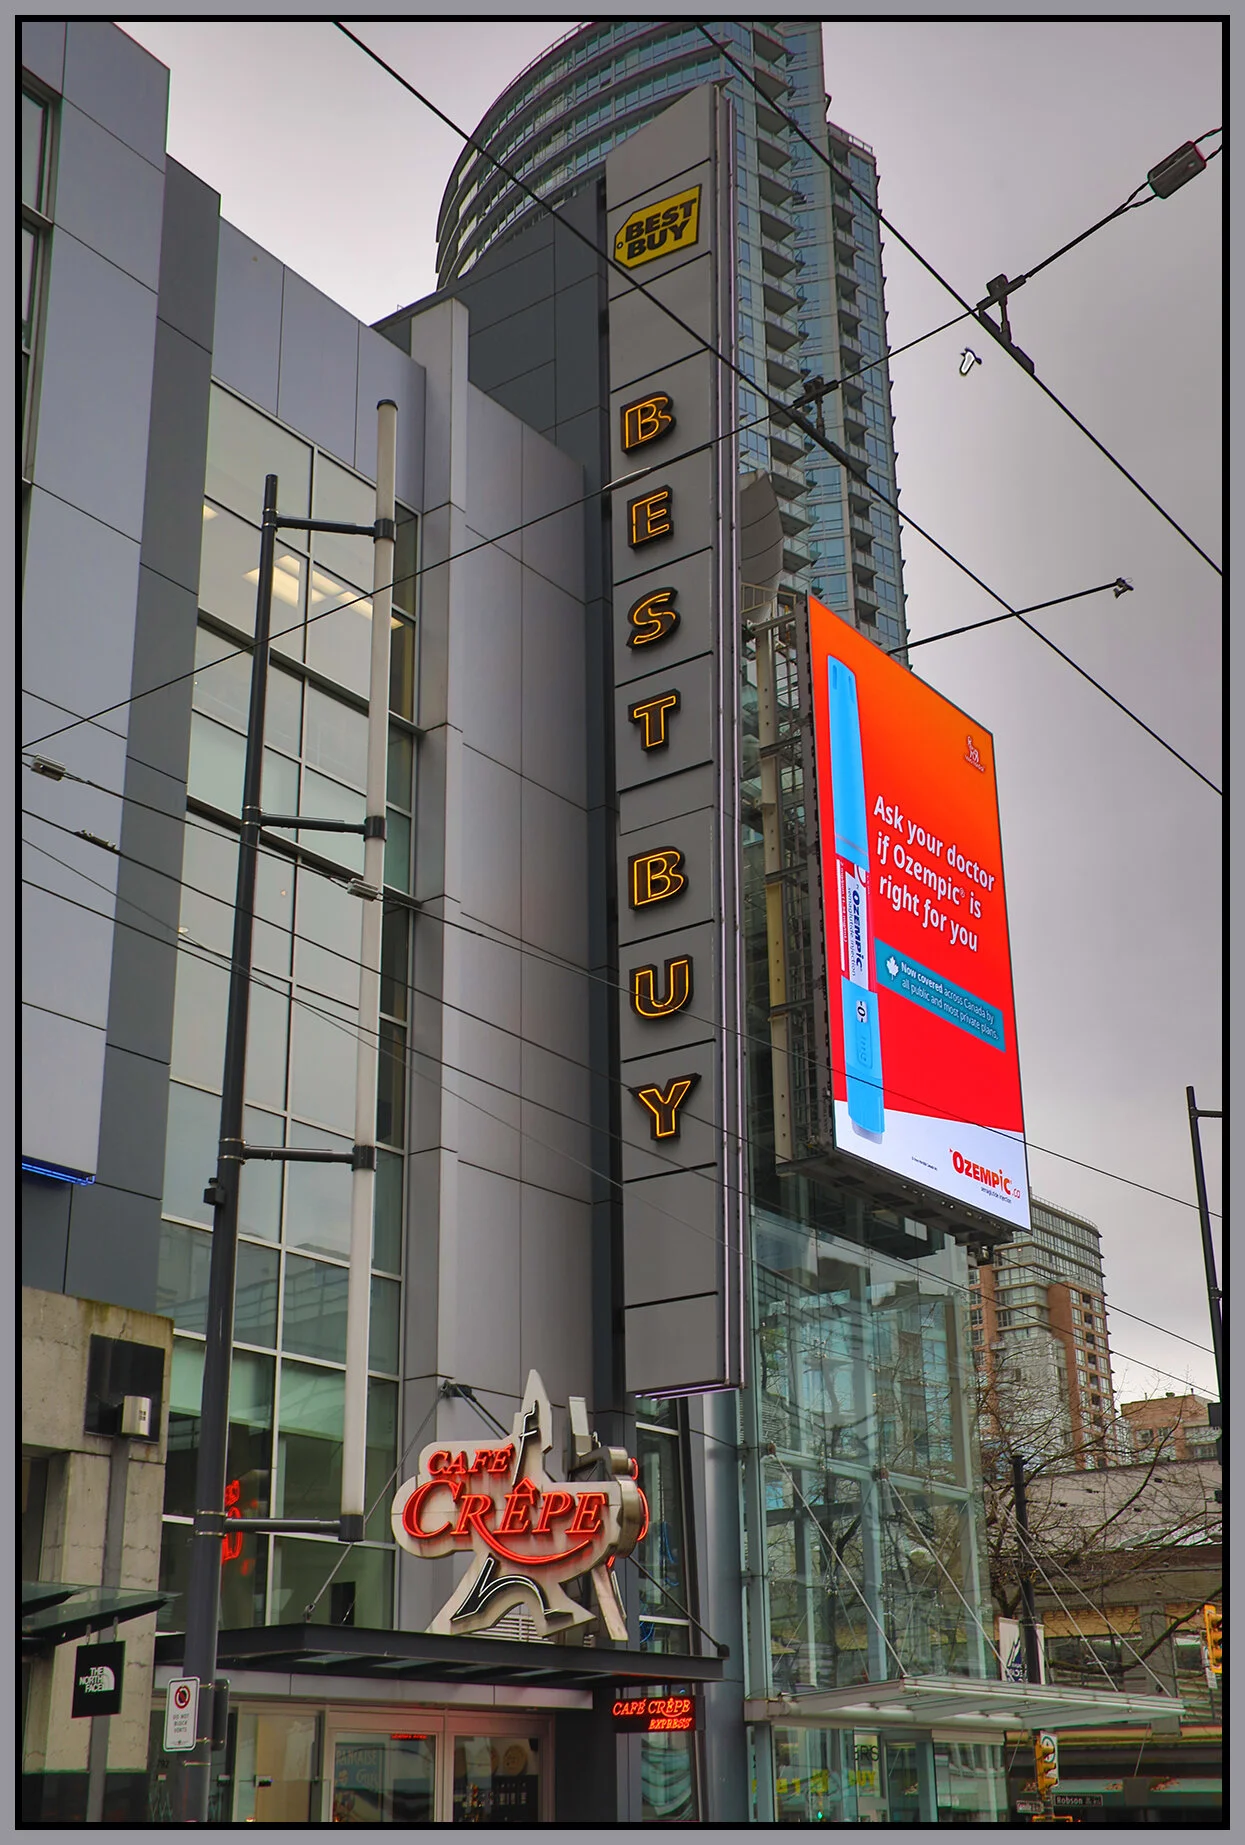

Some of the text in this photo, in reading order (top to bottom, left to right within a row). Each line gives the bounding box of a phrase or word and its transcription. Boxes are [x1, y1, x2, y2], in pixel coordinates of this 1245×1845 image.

[625, 198, 697, 242] BEST
[627, 219, 690, 260] BUY
[620, 391, 702, 1142] BEST BUY
[874, 796, 996, 892] Ask your doctor
[877, 832, 890, 865] if
[970, 892, 982, 918] is
[880, 875, 920, 916] right
[922, 899, 947, 932] for
[950, 920, 978, 952] you
[902, 962, 994, 1025] Now covered across Canada by
[902, 978, 910, 990] all
[911, 984, 930, 1002] public
[930, 996, 942, 1008] and
[944, 1002, 959, 1018] most
[960, 1012, 980, 1030] private
[427, 1442, 515, 1476] CAFÉ
[402, 1476, 608, 1565] CRÊPE
[79, 1676, 103, 1686] NORTH
[85, 1684, 103, 1693] FACE
[90, 1667, 104, 1676] THE
[612, 1698, 691, 1718] CAFÉ CRÊPE
[648, 1718, 693, 1730] EXPRESS
[1056, 1796, 1083, 1806] Robson
